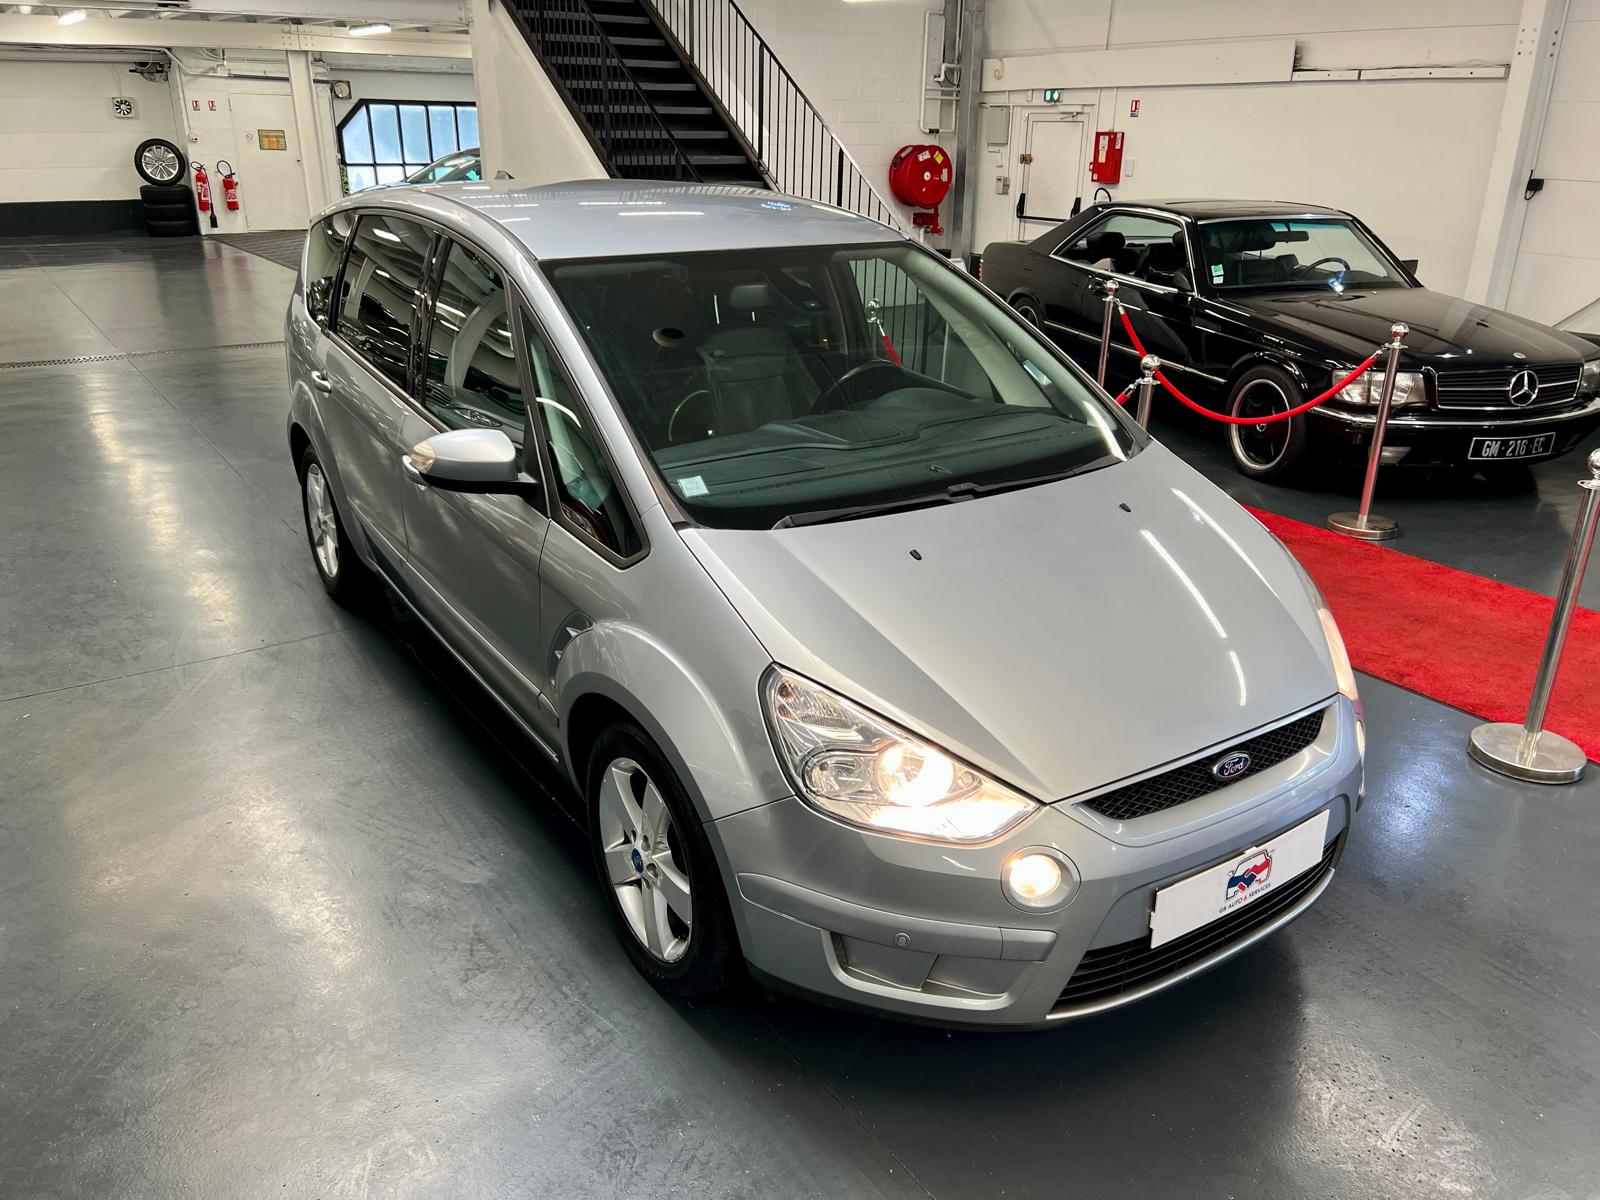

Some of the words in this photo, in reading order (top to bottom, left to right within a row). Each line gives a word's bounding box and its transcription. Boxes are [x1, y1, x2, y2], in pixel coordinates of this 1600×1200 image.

[1481, 440, 1501, 457] GM
[1505, 439, 1529, 457] 216
[1223, 757, 1244, 776] Ford
[1227, 897, 1243, 909] AUTO
[1248, 881, 1272, 898] SERVICES
